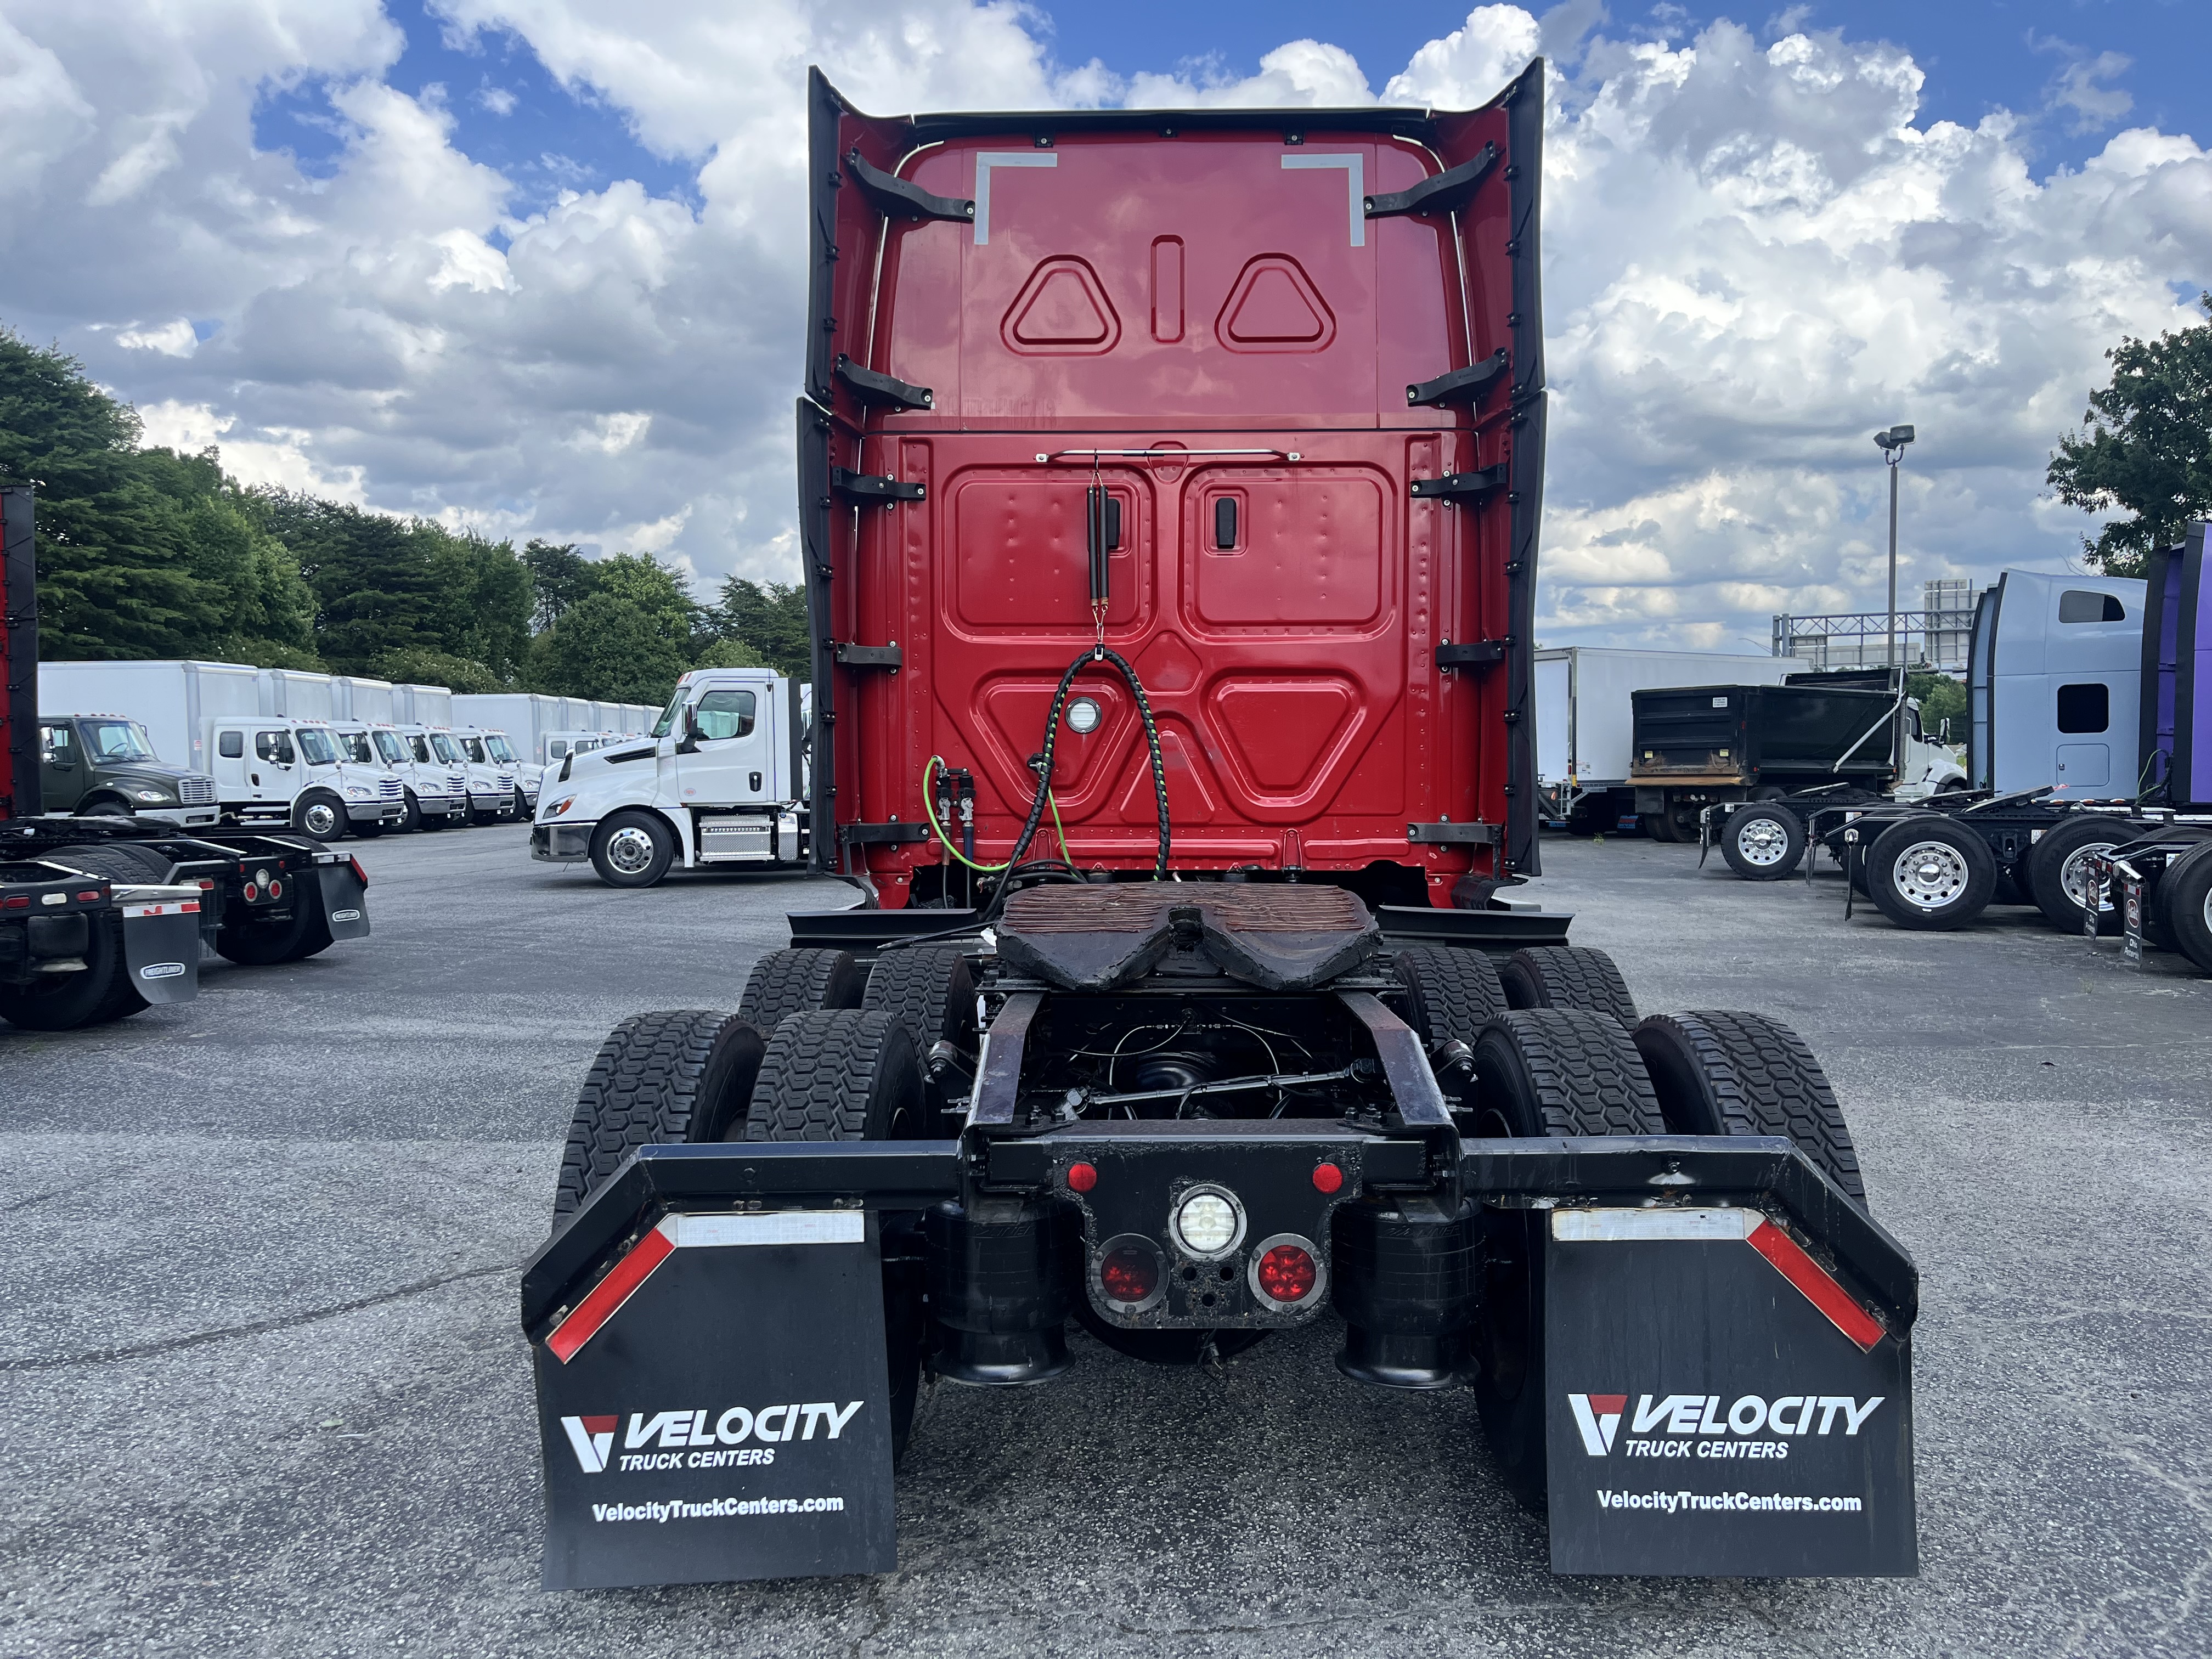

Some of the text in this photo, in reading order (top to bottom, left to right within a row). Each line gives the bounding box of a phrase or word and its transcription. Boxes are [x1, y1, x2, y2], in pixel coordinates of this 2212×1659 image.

[624, 1401, 865, 1449] VELOCITY
[1631, 1394, 1886, 1435] VELOCITY
[619, 1448, 775, 1471] TRUCK CENTERS
[1626, 1440, 1789, 1459] TRUCK CENTERS
[591, 1496, 844, 1523] VelocityTruckCenters.com
[1596, 1489, 1862, 1513] VelocityTruckCenters.com
